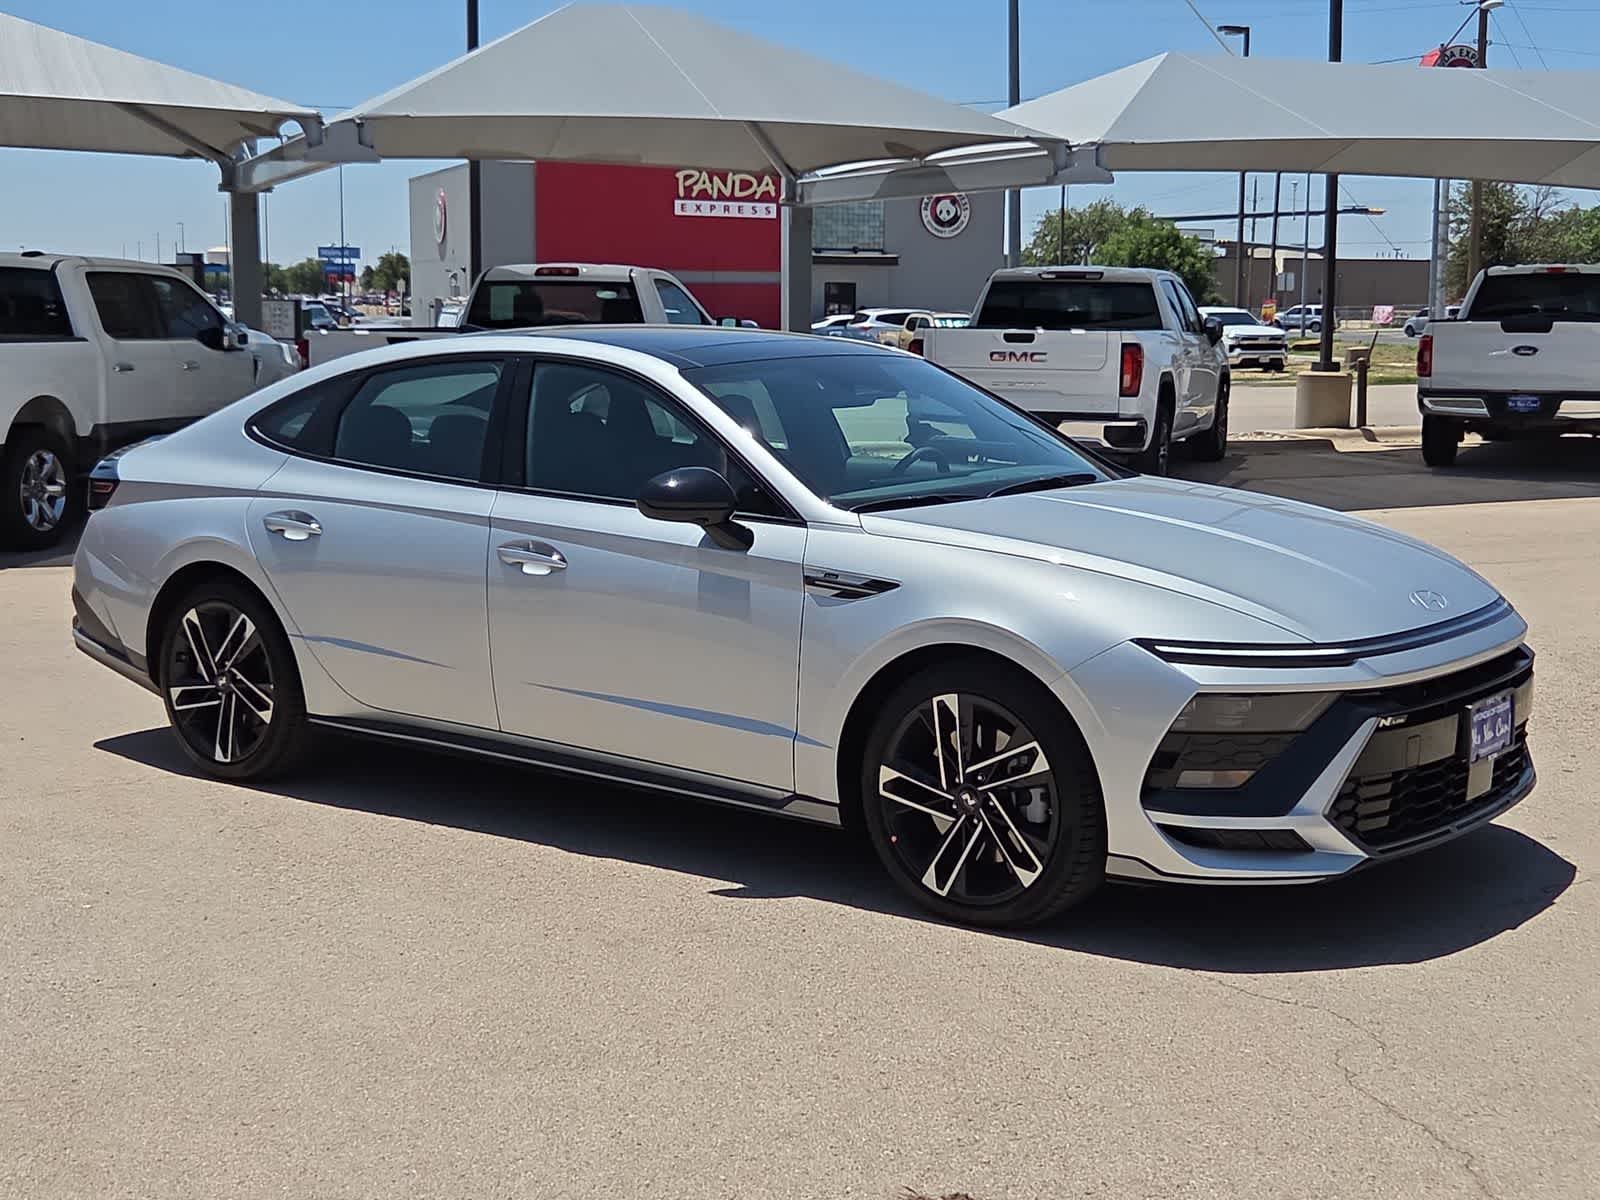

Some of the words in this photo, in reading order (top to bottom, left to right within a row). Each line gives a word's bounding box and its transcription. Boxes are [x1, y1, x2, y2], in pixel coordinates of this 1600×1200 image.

[675, 169, 776, 199] PANDA
[680, 203, 772, 215] EXPRESS
[989, 351, 1048, 363] GMC
